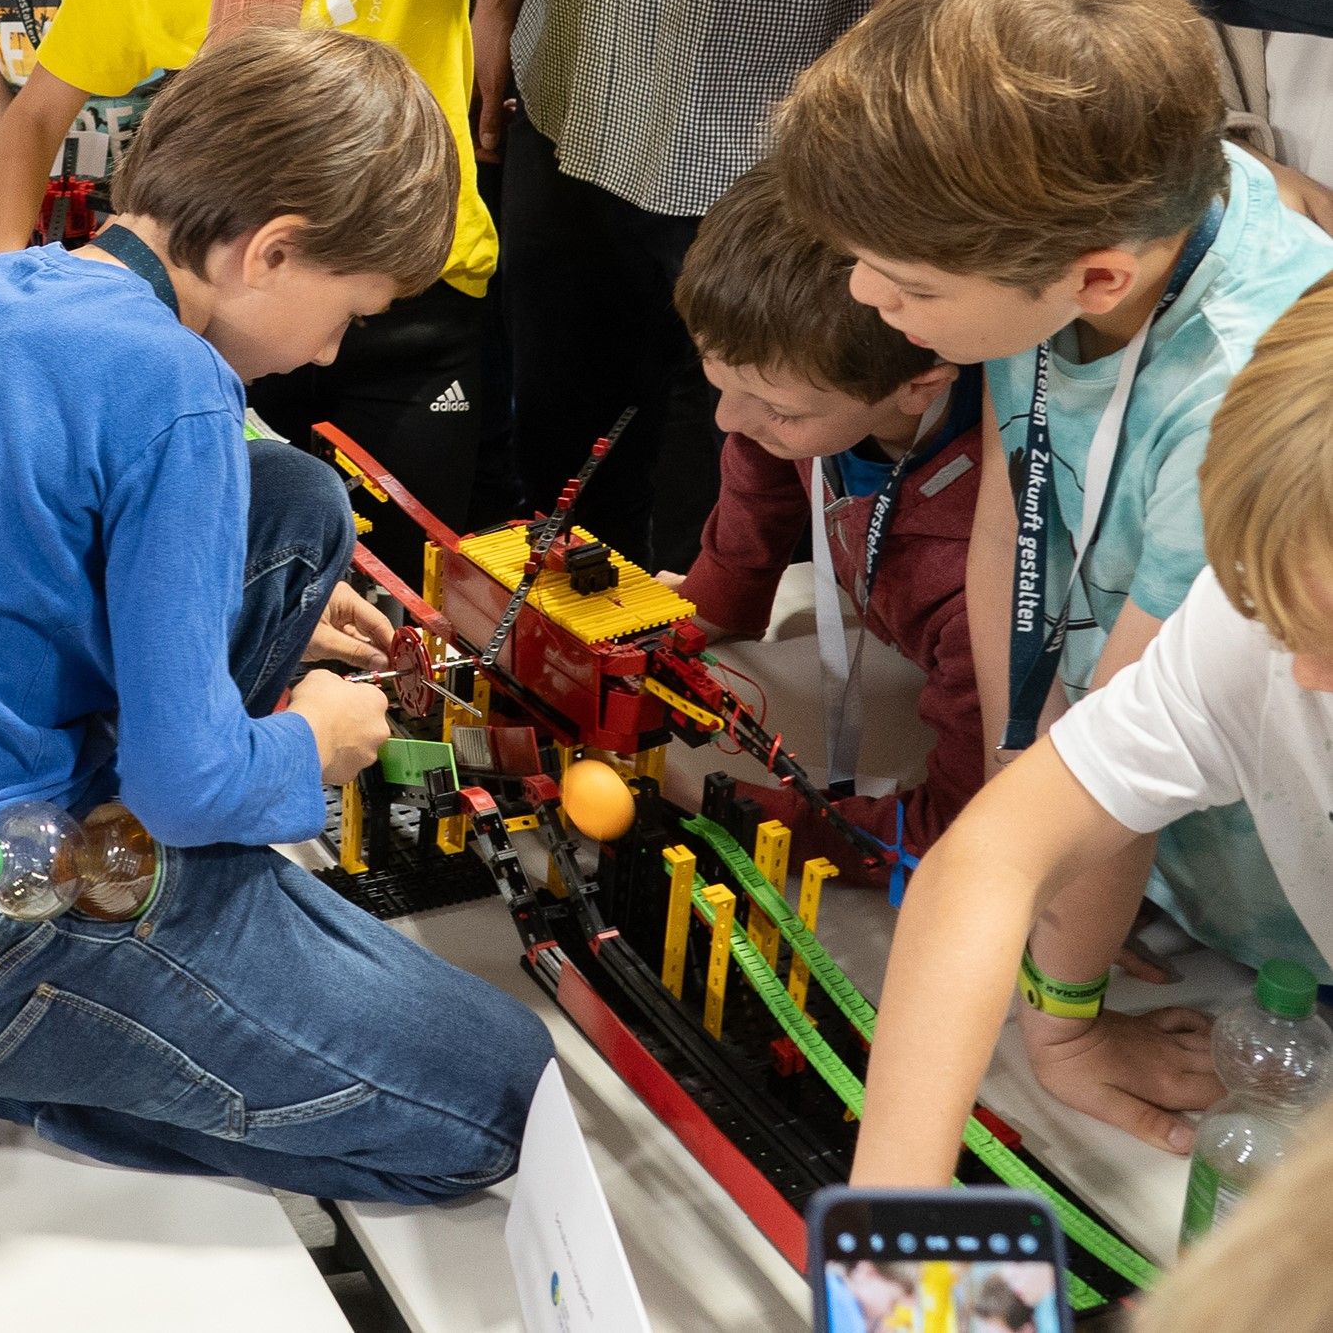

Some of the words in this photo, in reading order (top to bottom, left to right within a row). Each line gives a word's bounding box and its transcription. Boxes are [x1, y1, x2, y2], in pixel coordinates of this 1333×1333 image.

[429, 399, 470, 412] adidas
[1023, 447, 1049, 534] Zukunft
[1017, 534, 1041, 633] gestalten
